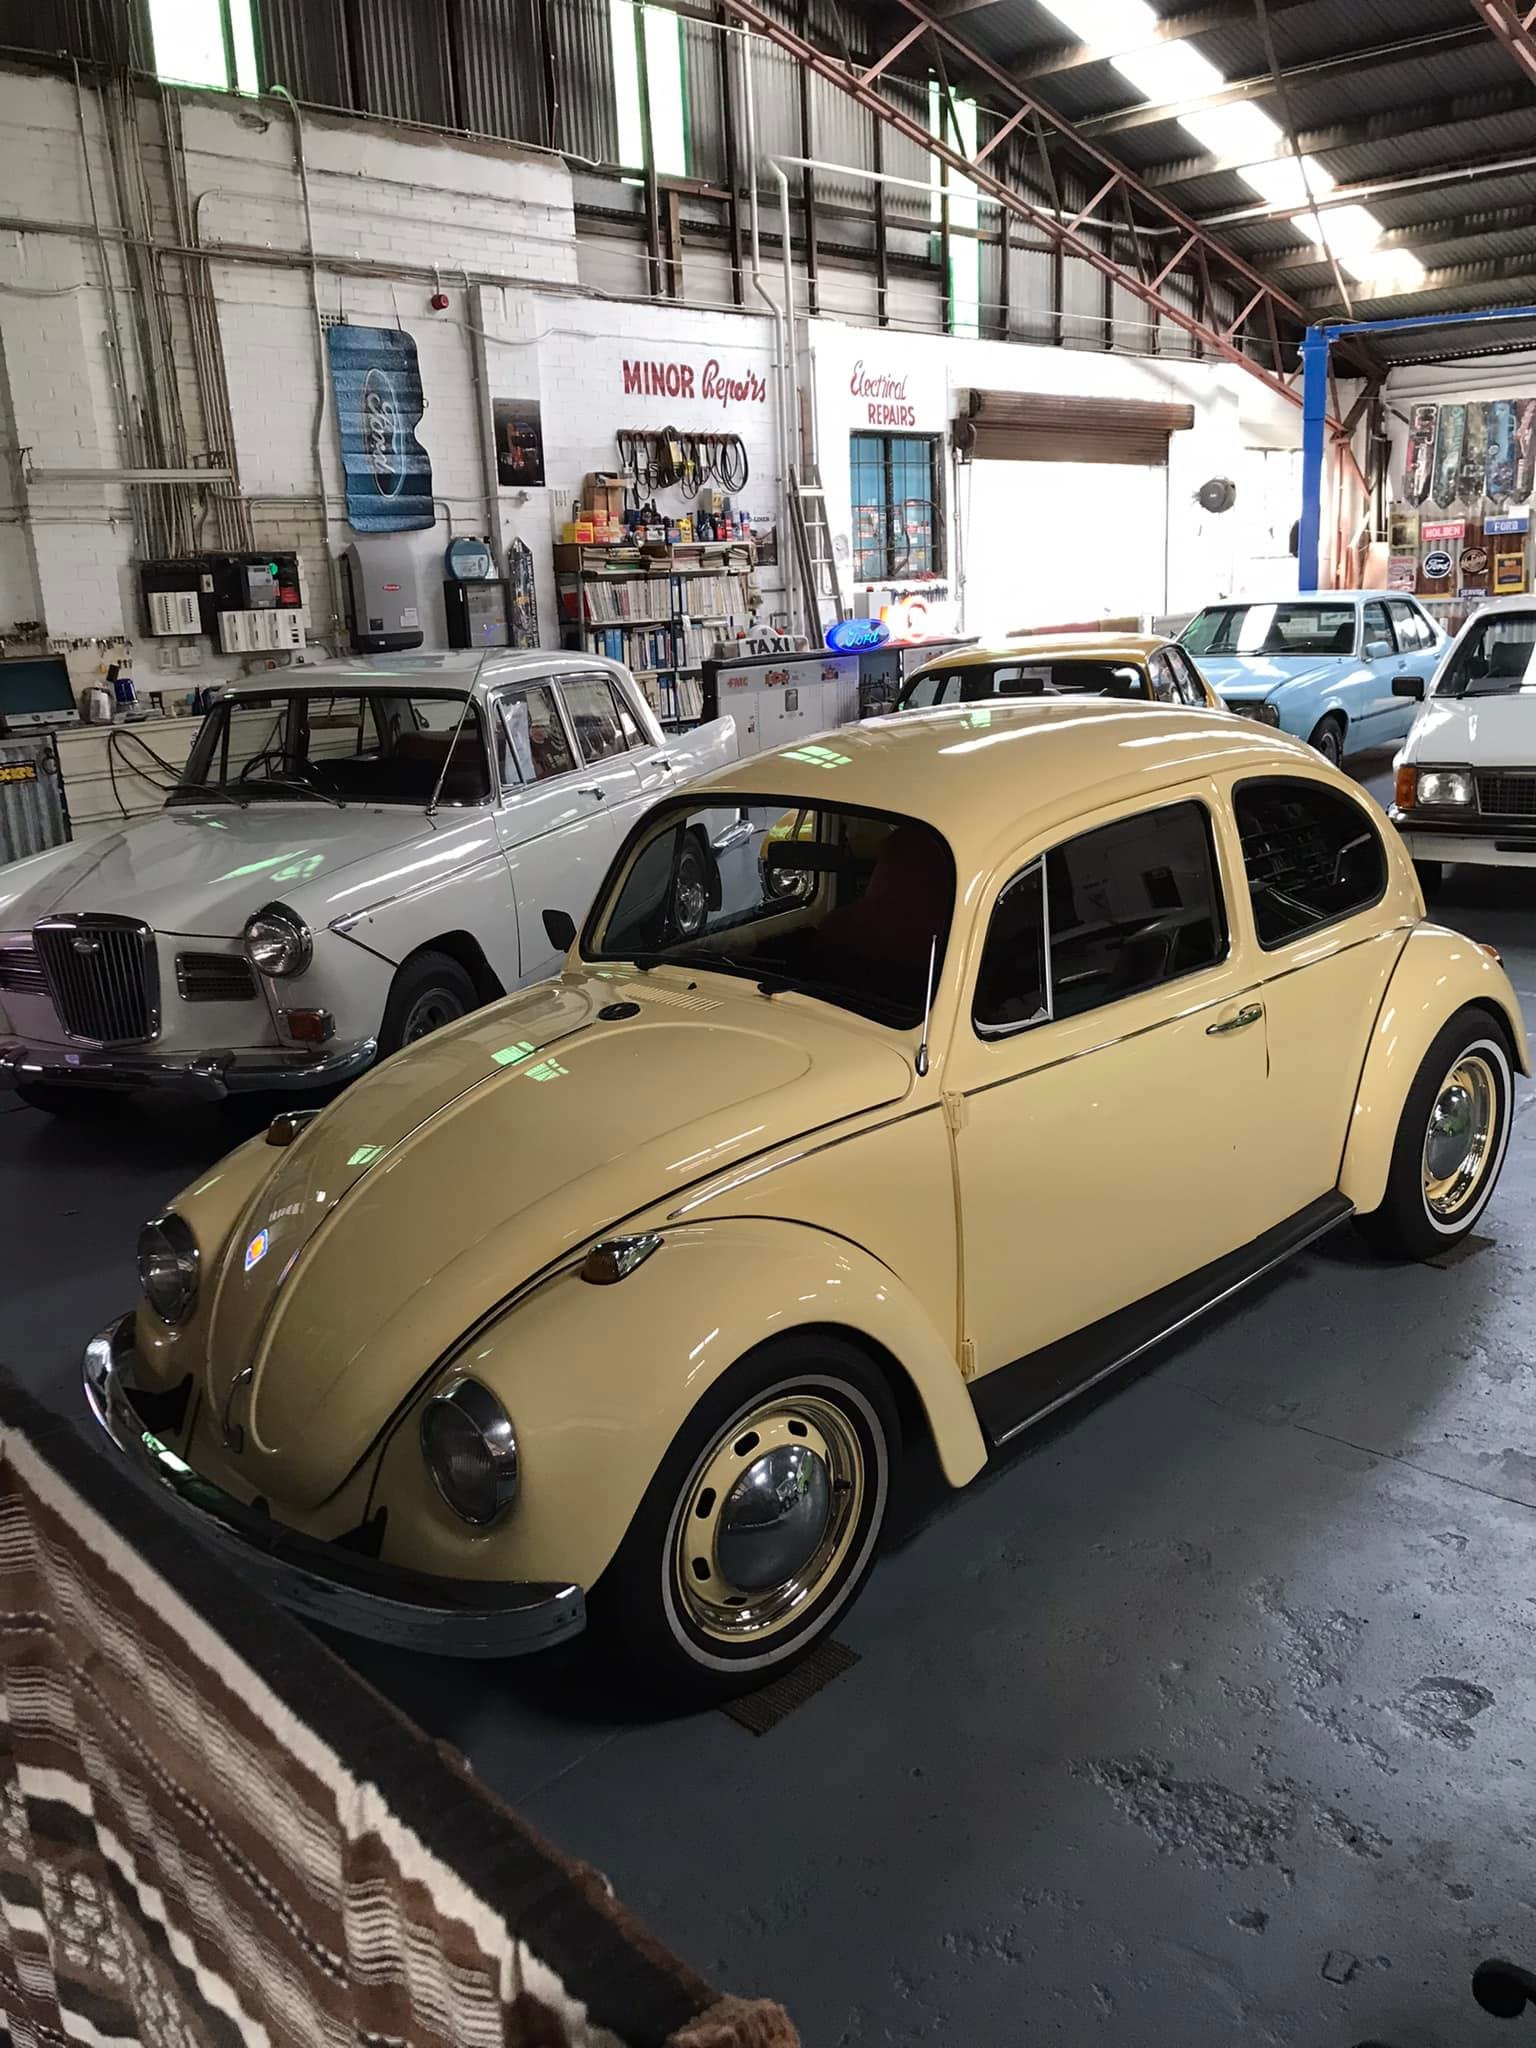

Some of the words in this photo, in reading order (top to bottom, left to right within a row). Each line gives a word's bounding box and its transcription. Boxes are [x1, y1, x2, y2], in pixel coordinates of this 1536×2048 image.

[622, 360, 694, 398] MINOR
[702, 359, 766, 408] Repairs
[850, 360, 908, 400] Electrical
[868, 403, 915, 426] REPAIRS
[366, 392, 398, 475] Ford
[1494, 520, 1519, 531] FORD
[1426, 558, 1450, 571] Ford
[746, 636, 790, 655] TAXI
[844, 624, 880, 647] Ford
